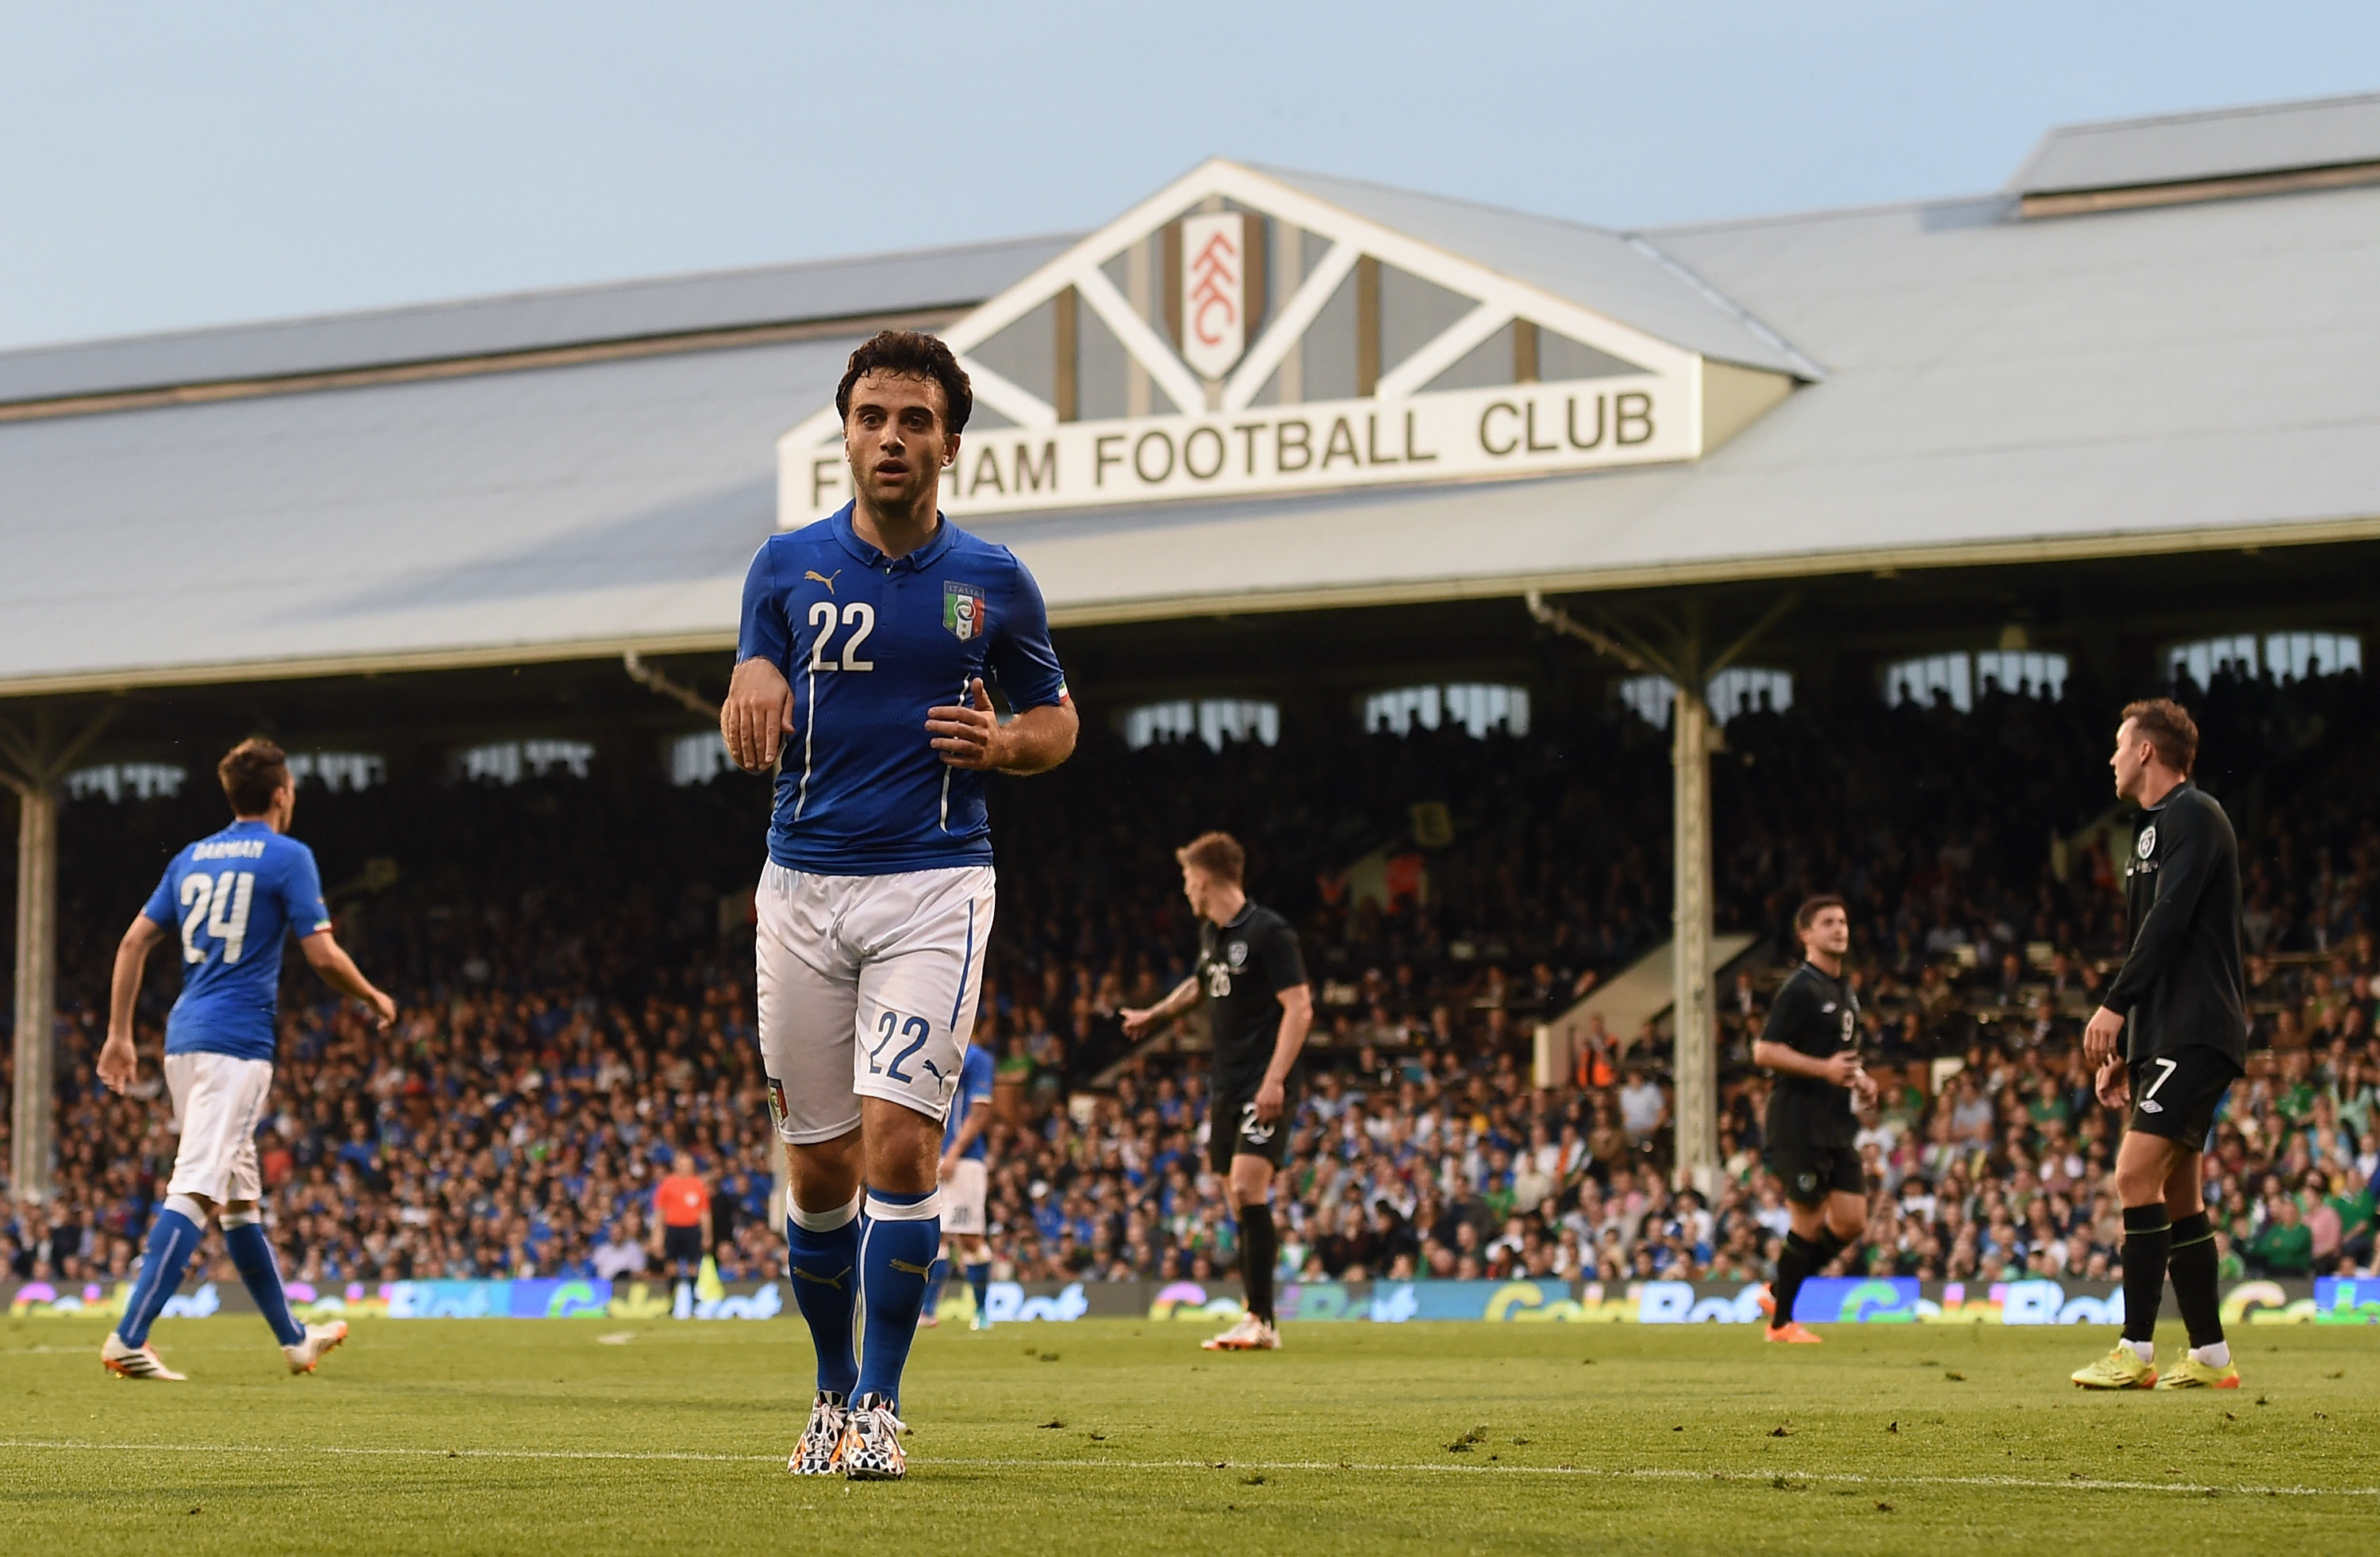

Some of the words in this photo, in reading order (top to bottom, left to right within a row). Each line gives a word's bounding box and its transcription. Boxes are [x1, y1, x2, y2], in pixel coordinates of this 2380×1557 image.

[1094, 409, 1438, 486] FOOTBALL
[1480, 391, 1656, 456] CLUB
[808, 601, 875, 672] 22
[180, 870, 255, 964] 24
[869, 1010, 931, 1085] 22
[1841, 1009, 1855, 1042] 9
[2146, 1057, 2178, 1099] 7
